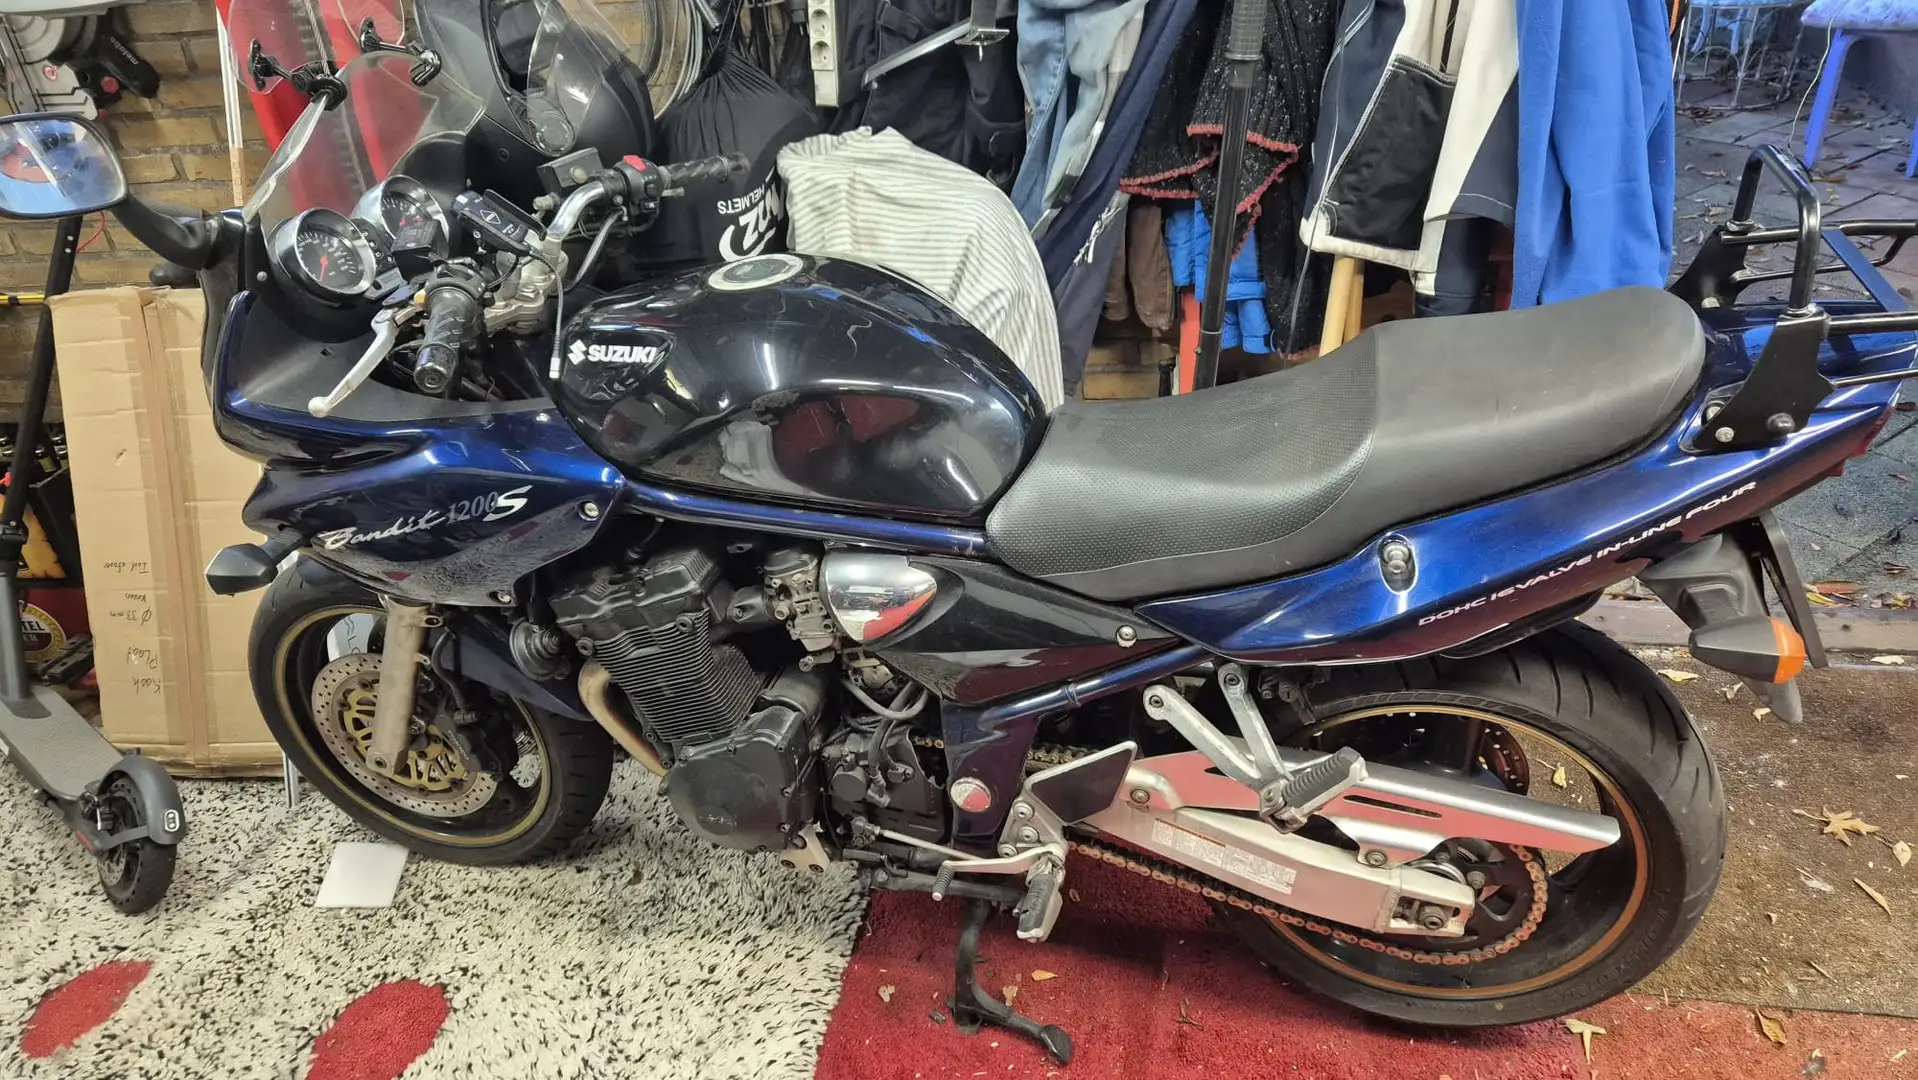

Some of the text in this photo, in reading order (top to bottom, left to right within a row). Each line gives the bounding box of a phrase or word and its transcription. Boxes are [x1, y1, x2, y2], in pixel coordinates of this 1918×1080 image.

[110, 36, 139, 65] metabo
[716, 184, 765, 215] HELMETS
[587, 344, 658, 363] SUZUKI
[317, 509, 446, 550] Bandit
[1418, 597, 1487, 626] DOHC
[1596, 515, 1682, 559] IN-LINE
[1685, 481, 1757, 520] FOUR
